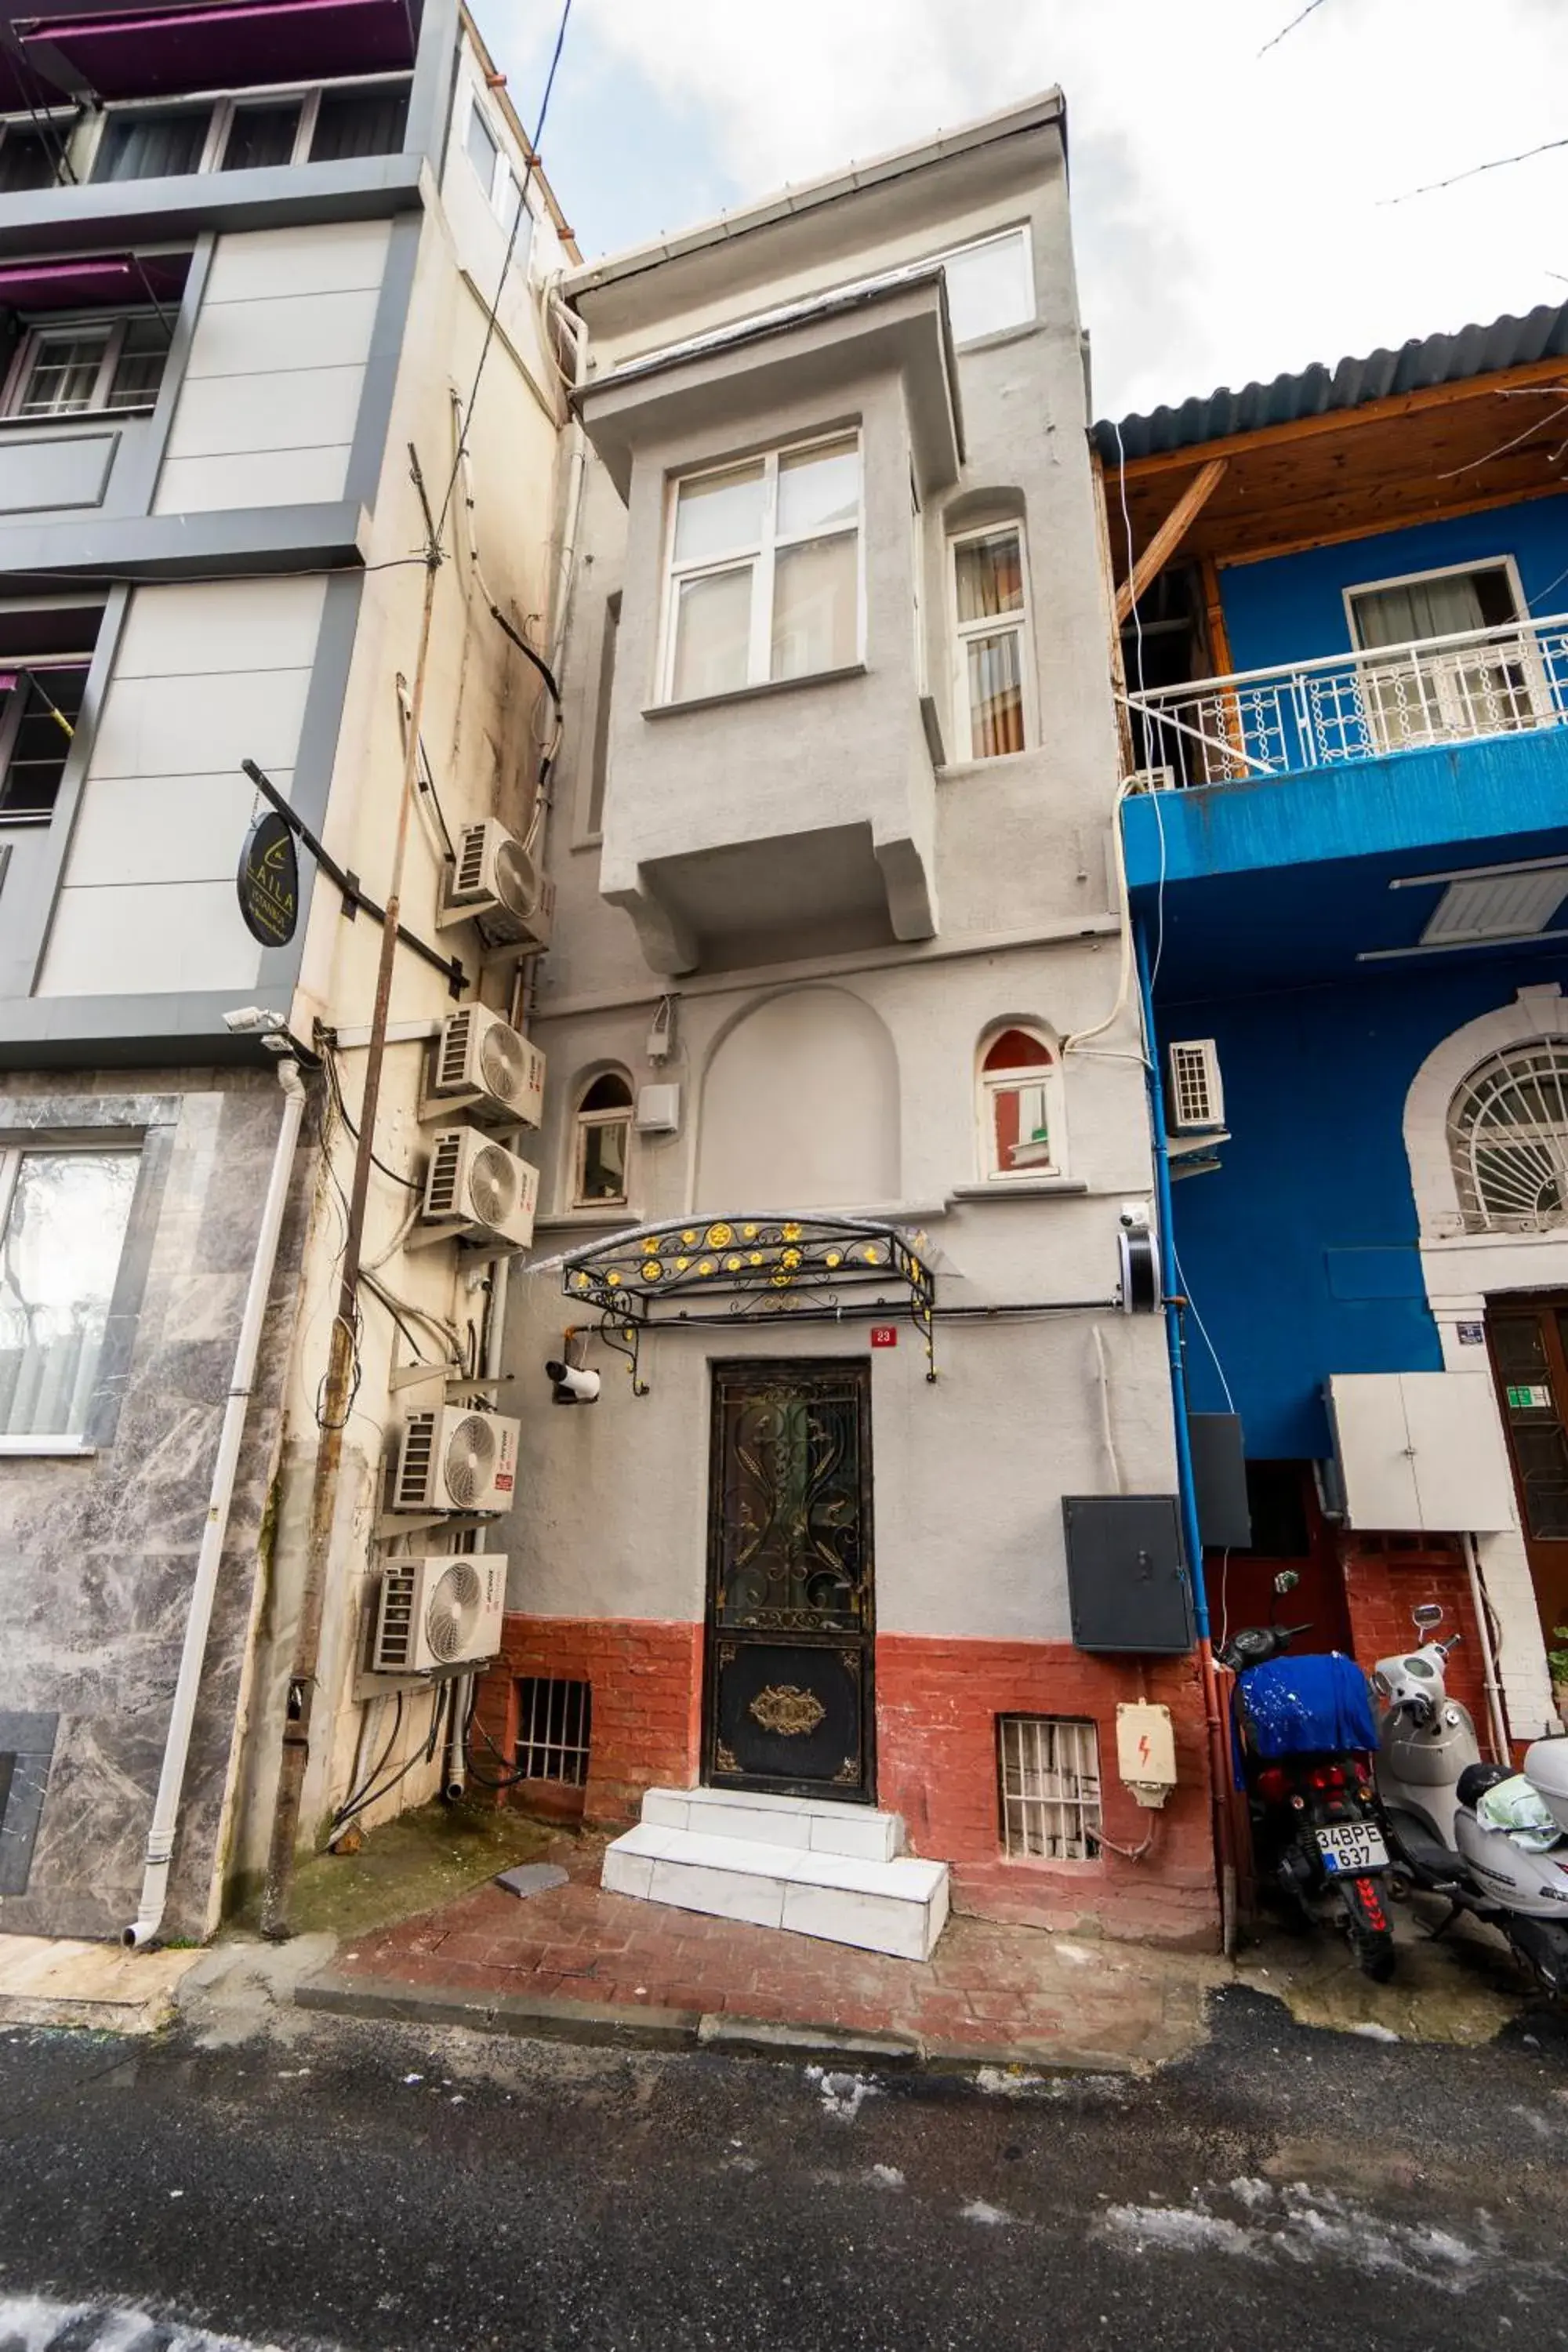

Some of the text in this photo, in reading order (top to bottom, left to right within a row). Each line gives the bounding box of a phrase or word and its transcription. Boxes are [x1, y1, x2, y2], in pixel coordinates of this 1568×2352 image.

[877, 1330, 890, 1342] 23
[1316, 1824, 1381, 1848] 34BPE
[1338, 1846, 1370, 1867] 637
